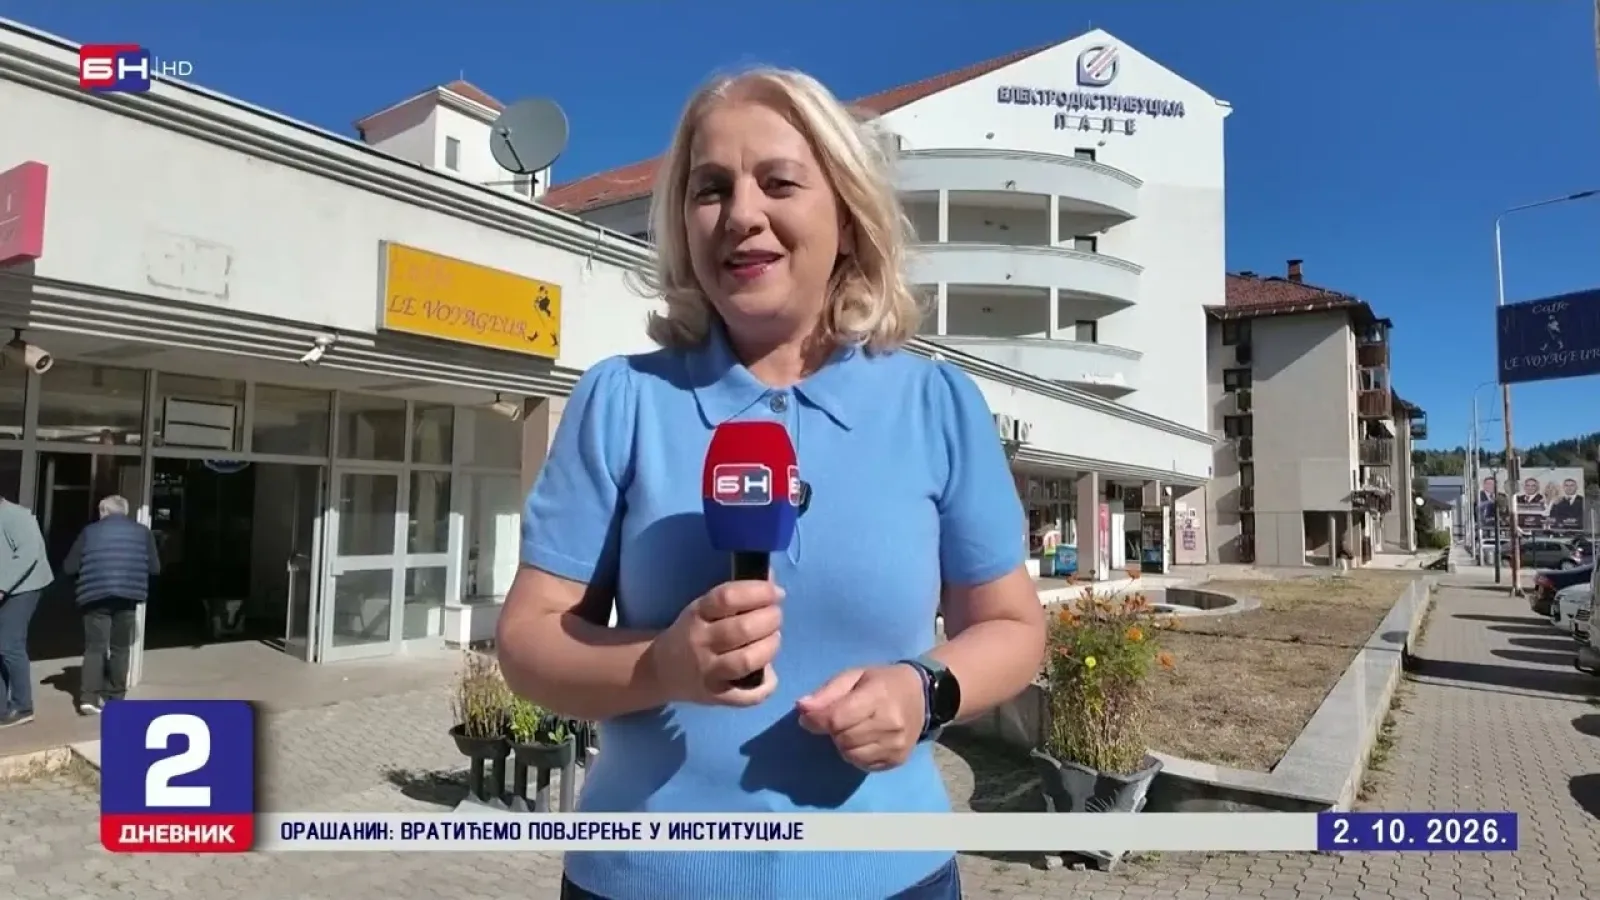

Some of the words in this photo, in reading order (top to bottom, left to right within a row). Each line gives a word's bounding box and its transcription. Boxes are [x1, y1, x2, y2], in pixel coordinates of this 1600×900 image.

[997, 85, 1186, 118] ЕЛЕКТРОДИСТРИБУЦИЈА
[389, 294, 418, 317] LE
[423, 299, 528, 341] VOYAGEUR
[1504, 355, 1520, 371] LE
[716, 475, 768, 494] БН
